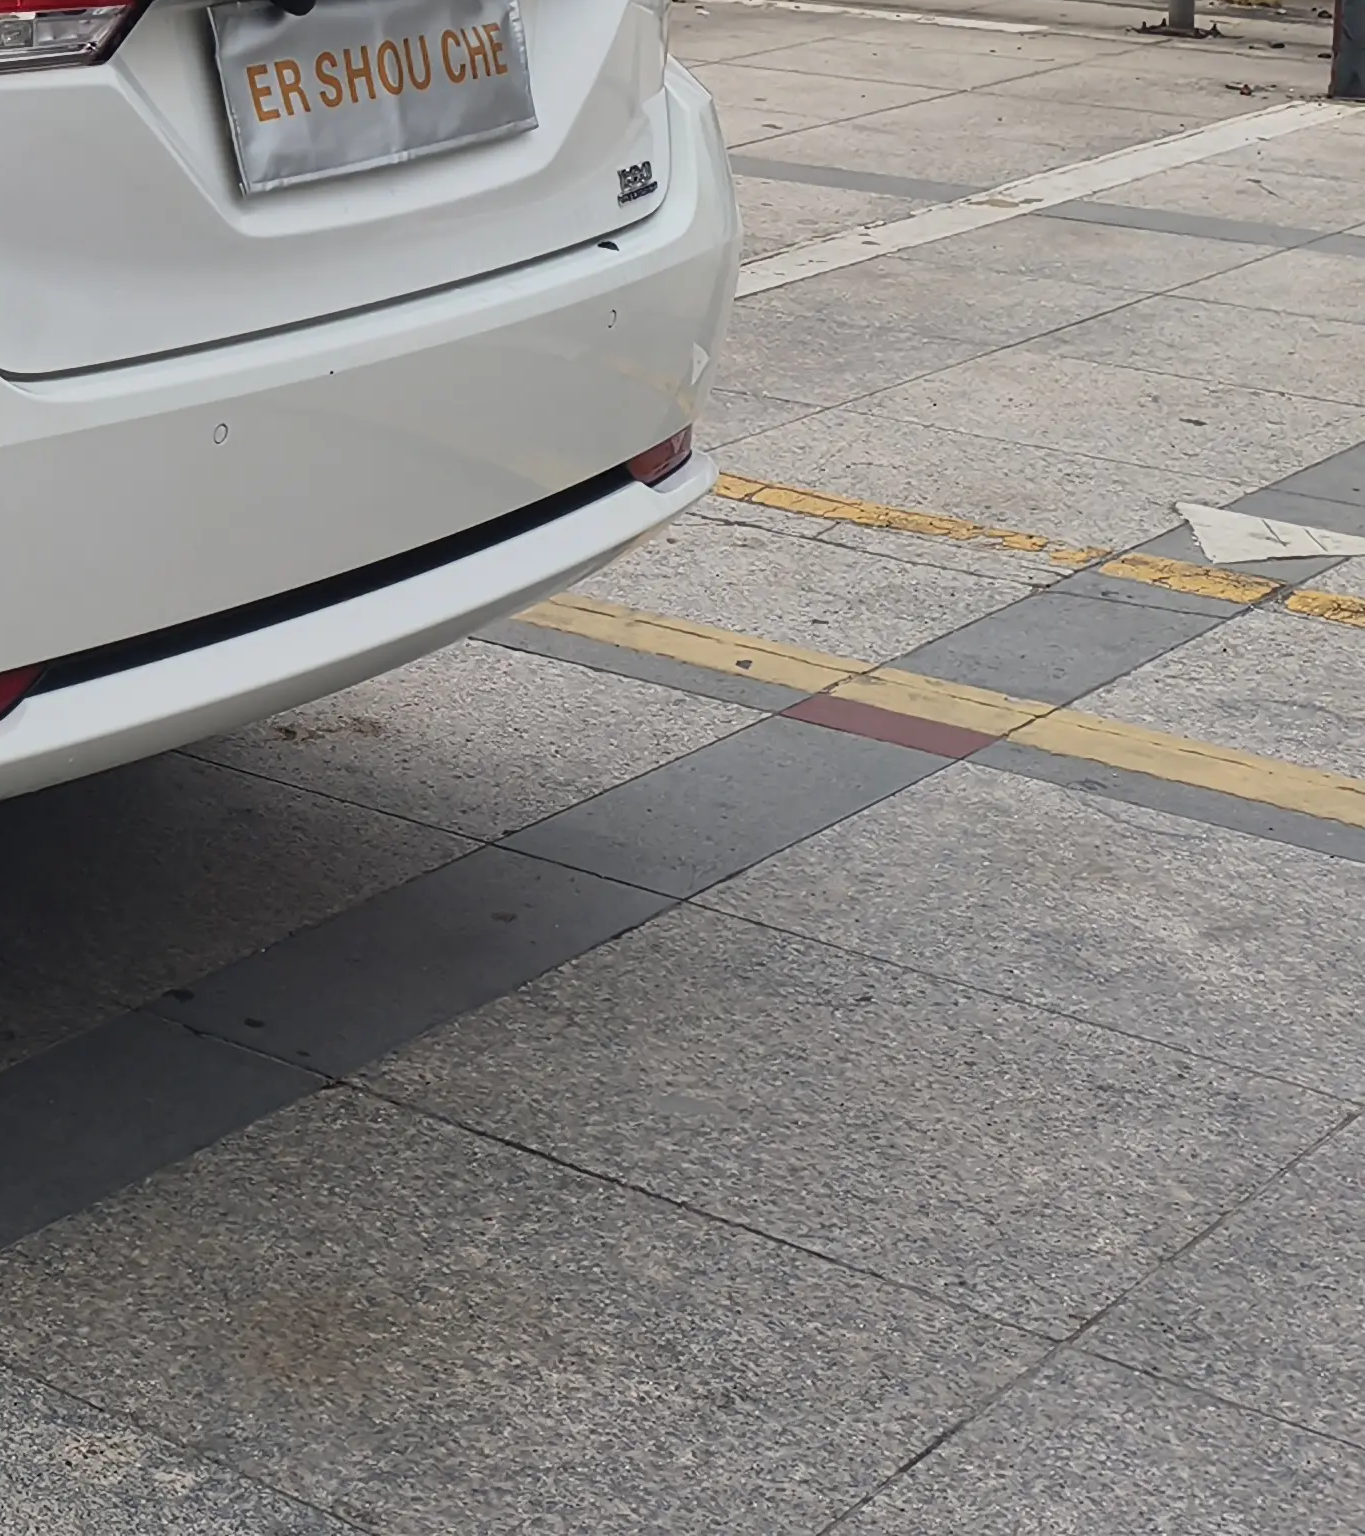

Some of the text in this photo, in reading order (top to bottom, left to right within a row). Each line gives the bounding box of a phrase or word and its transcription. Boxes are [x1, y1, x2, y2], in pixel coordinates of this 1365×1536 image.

[245, 22, 509, 123] ER SHOU CHE
